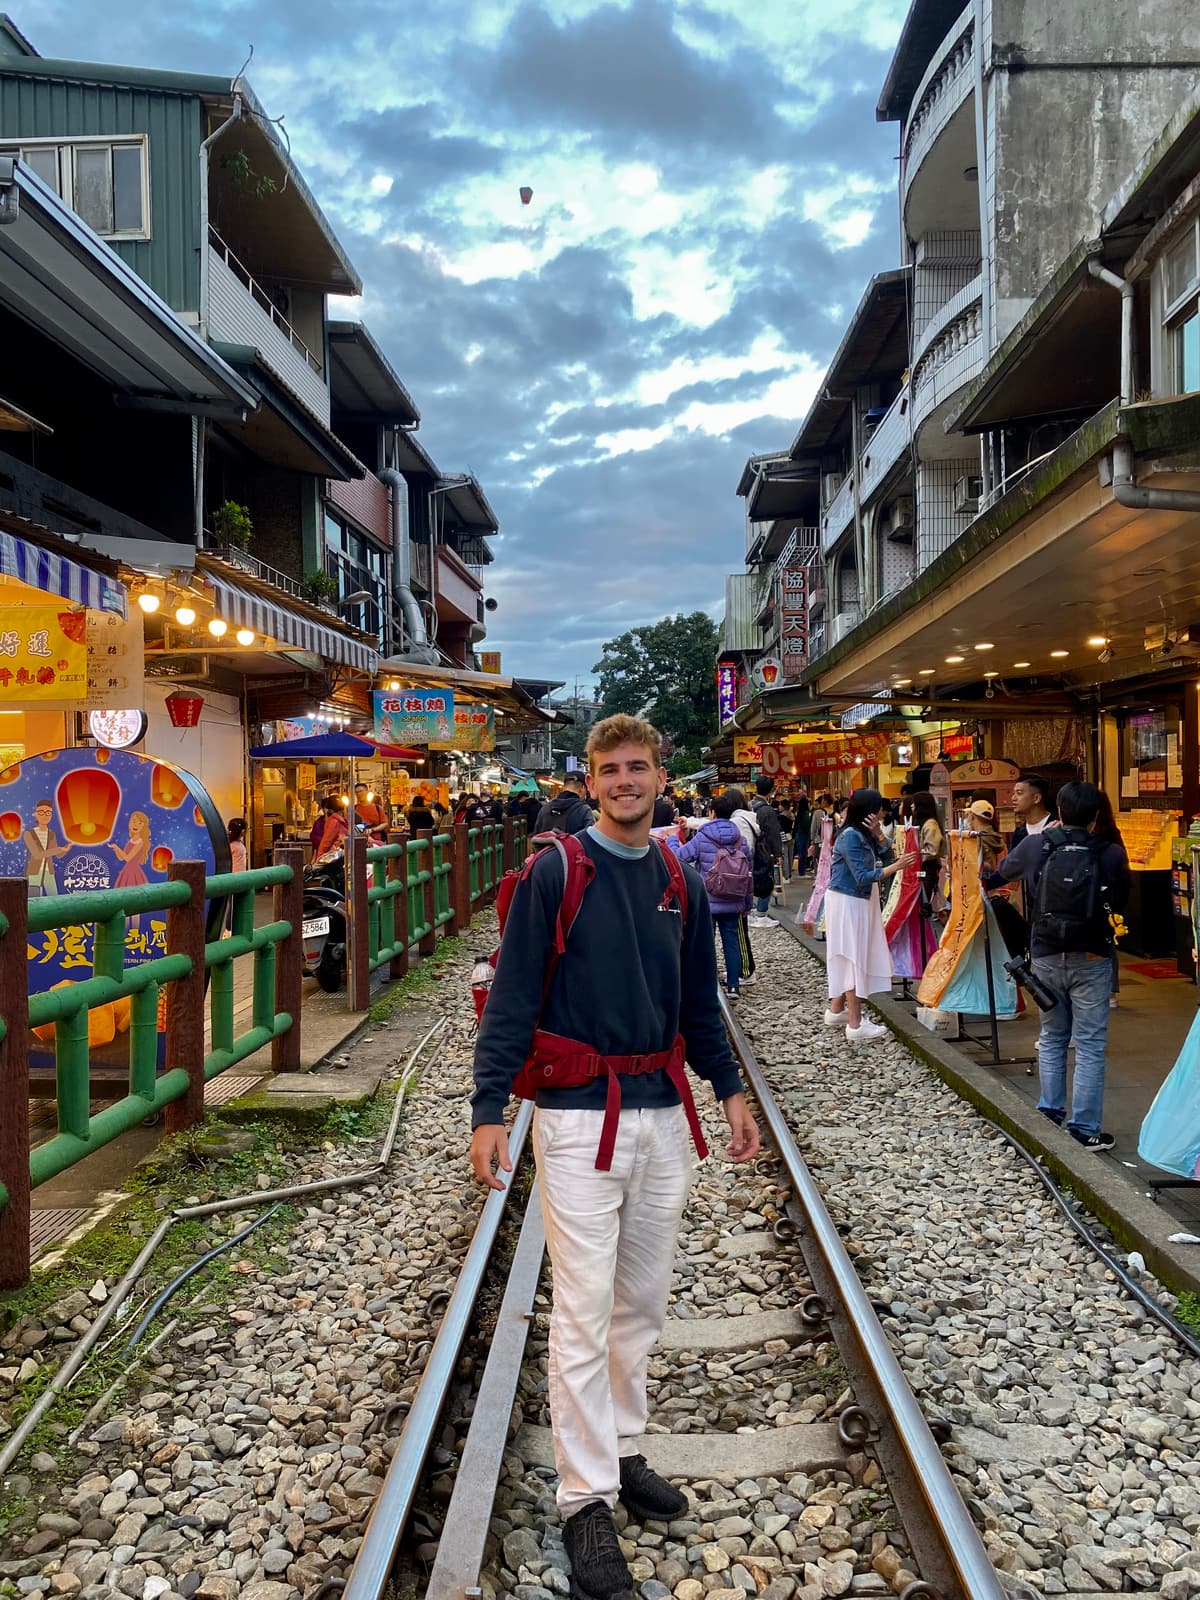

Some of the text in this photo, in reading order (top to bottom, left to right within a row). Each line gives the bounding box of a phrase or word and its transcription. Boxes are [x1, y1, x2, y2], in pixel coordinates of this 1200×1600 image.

[0, 630, 53, 658] 好運
[382, 697, 446, 713] 花枝燒
